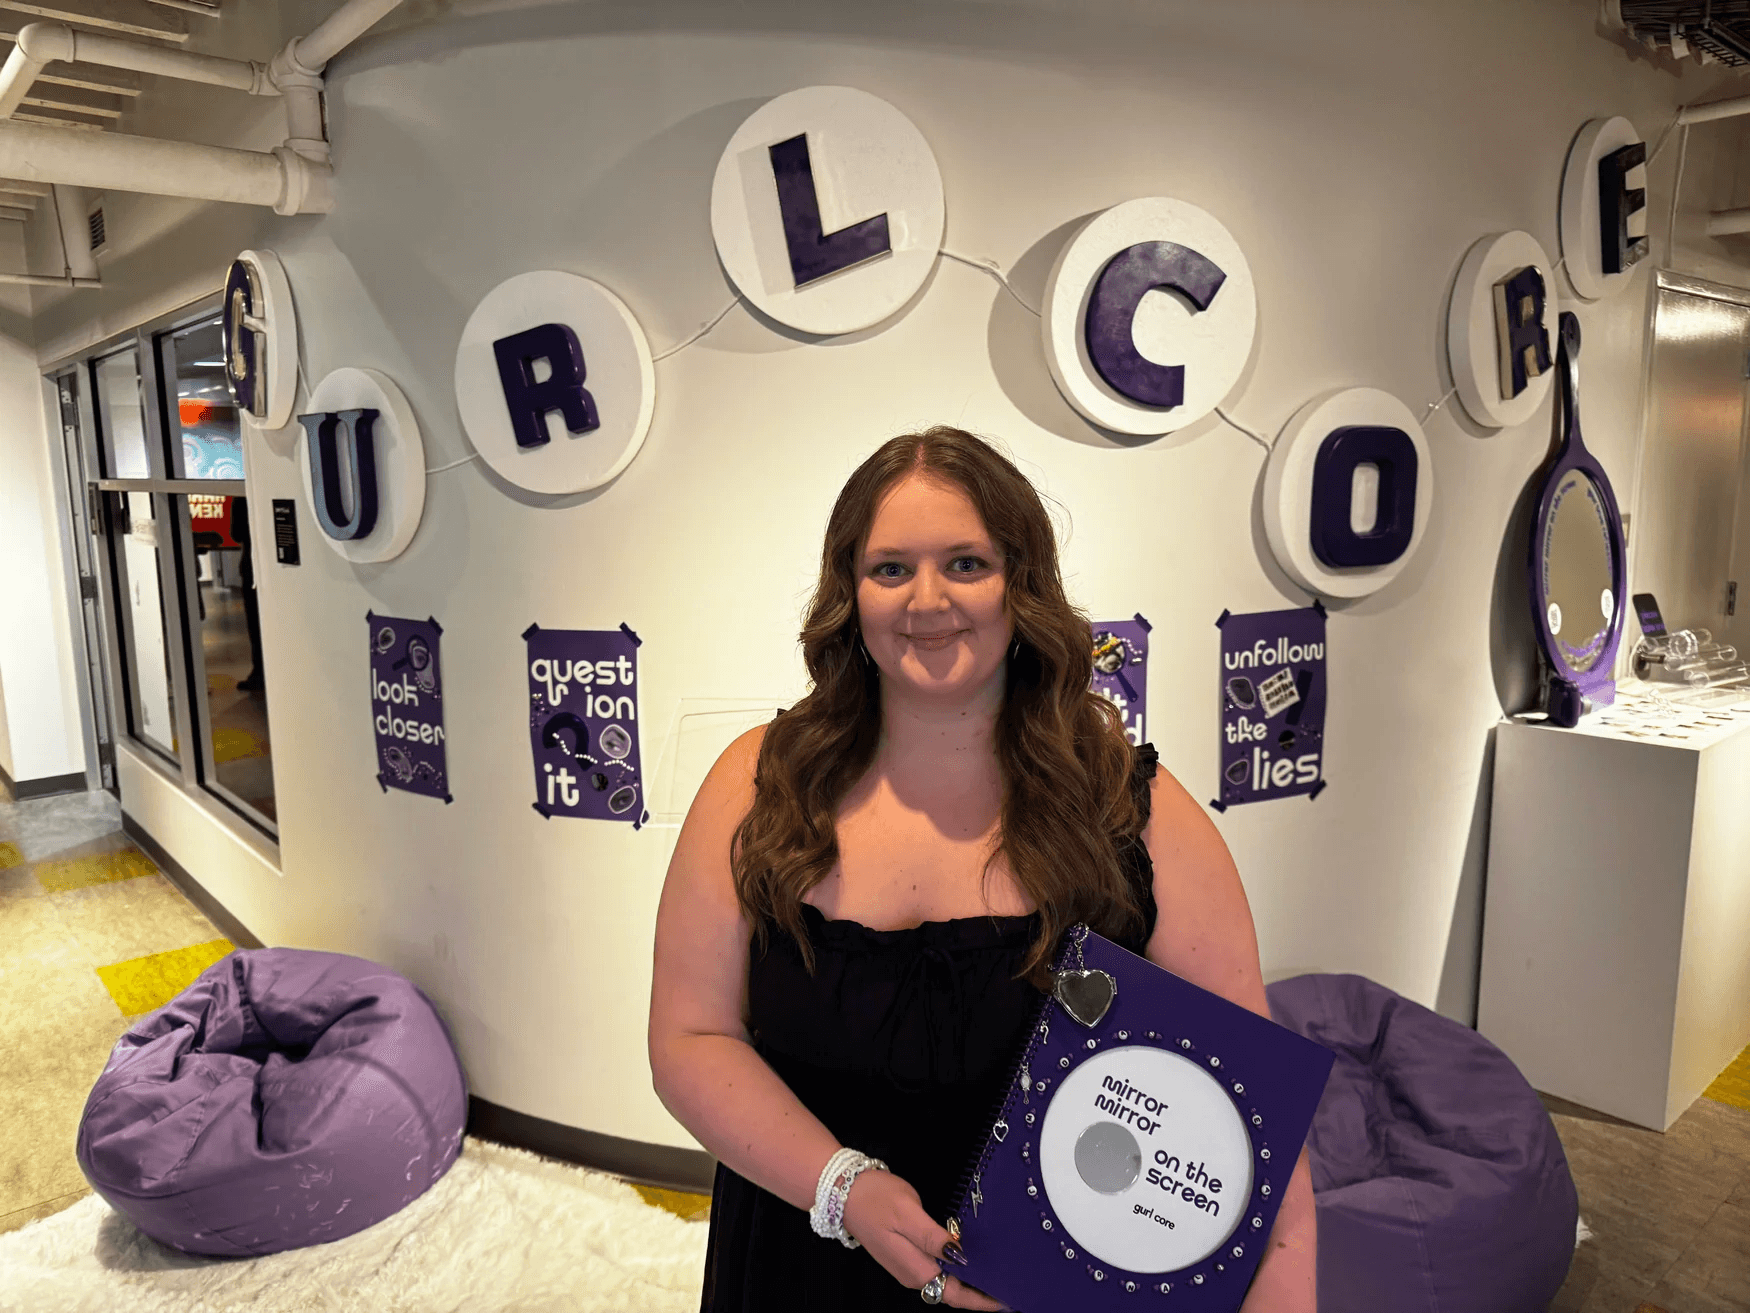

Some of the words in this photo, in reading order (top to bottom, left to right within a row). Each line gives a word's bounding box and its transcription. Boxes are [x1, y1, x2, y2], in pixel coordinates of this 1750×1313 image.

[1224, 637, 1324, 670] unfollow
[373, 668, 419, 706] look
[585, 686, 635, 720] ion
[376, 705, 445, 746] closer
[1225, 716, 1267, 744] the
[544, 763, 580, 807] it
[1252, 746, 1319, 791] lies
[1094, 1093, 1162, 1135] mirror
[1102, 1075, 1169, 1117] mirror
[1145, 1167, 1220, 1217] screen
[1154, 1149, 1181, 1173] on
[1185, 1161, 1223, 1194] the
[1132, 1203, 1154, 1219] gurl
[1154, 1213, 1175, 1230] core
